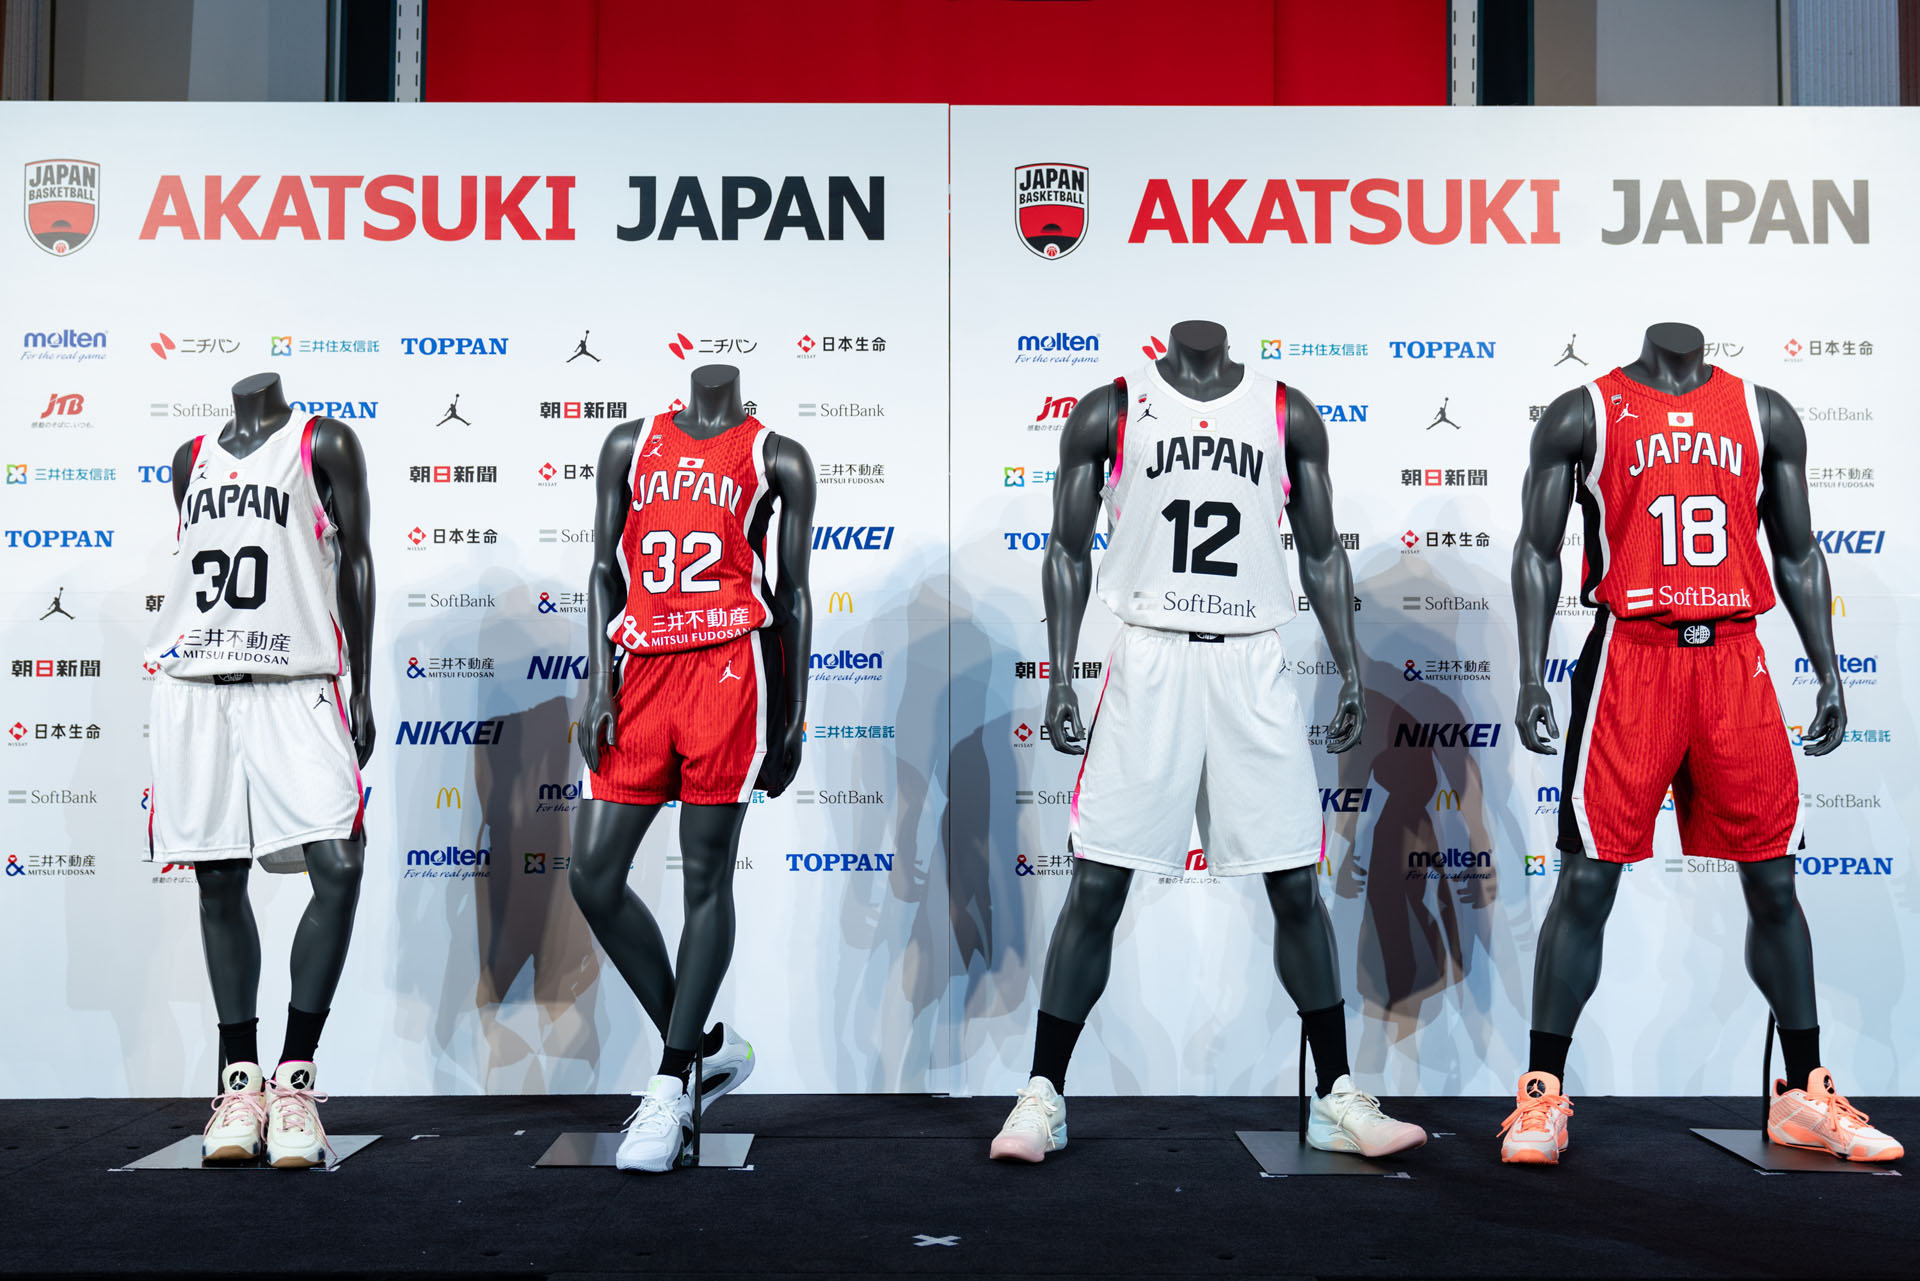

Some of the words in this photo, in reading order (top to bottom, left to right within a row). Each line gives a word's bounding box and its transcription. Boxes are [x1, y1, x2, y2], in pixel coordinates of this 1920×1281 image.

[29, 164, 95, 189] JAPAN
[1019, 168, 1085, 192] JAPAN
[29, 188, 95, 201] BASKETBALL
[1019, 191, 1085, 205] BASKETBALL
[138, 174, 576, 242] AKATSUKI
[617, 175, 885, 242] JAPAN
[1127, 177, 1561, 245] AKATSUKI
[1601, 179, 1870, 245] JAPAN
[24, 329, 107, 348] molten
[181, 338, 240, 354] ニチバン
[299, 340, 380, 353] 三井住友信託
[401, 337, 508, 355] TOPPAN
[698, 338, 757, 354] ニチバン
[823, 336, 887, 352] 日本生命
[1018, 332, 1099, 351] molten
[20, 350, 37, 361] For
[39, 350, 55, 360] the
[56, 350, 77, 360] real
[79, 353, 107, 363] game
[1288, 343, 1368, 356] 三井住友信託
[1389, 341, 1496, 359] TOPPAN
[1703, 341, 1744, 358] チバン
[1809, 340, 1873, 356] 日本生命
[1015, 353, 1030, 363] For
[1032, 353, 1048, 363] the
[1049, 353, 1070, 363] real
[1072, 356, 1099, 366] game
[40, 393, 85, 419] JTB
[289, 401, 378, 418] OPPAN
[540, 402, 627, 419] 朝日新聞
[820, 403, 885, 417] SoftBank
[1316, 404, 1368, 422] PAN
[1808, 407, 1874, 421] SoftBank
[1146, 435, 1264, 486] JAPAN
[1628, 431, 1743, 478] JAPAN
[35, 468, 116, 481] 三井住友信託
[410, 465, 497, 483] 朝日新聞
[819, 464, 885, 476] 三井不動産
[1401, 469, 1487, 486] 朝日新聞
[1809, 468, 1874, 480] 三井不動産
[632, 469, 744, 517] JAPAN
[185, 484, 290, 528] JAPAN
[5, 530, 114, 548] TOPPAN
[433, 528, 498, 544] 日本生命
[811, 526, 895, 550] IKKEI
[1161, 499, 1241, 577] 12
[1426, 531, 1490, 547] 日本生命
[1647, 495, 1728, 567] 18
[1812, 531, 1885, 554] KKEI
[641, 530, 723, 594] 32
[191, 545, 269, 614] 30
[430, 593, 495, 608] SoftBank
[1163, 590, 1257, 619] SoftBank
[1425, 597, 1490, 611] SoftBank
[1659, 586, 1751, 608] SoftBank
[651, 607, 750, 634] 三井不動産
[184, 628, 291, 653] 三井不動産
[651, 634, 689, 647] MITSUI
[183, 649, 225, 661] MITSUI
[227, 651, 290, 666] FUDOSAN
[428, 657, 495, 670] 三井不動産
[1795, 654, 1877, 673] mlten
[11, 659, 101, 677] 朝日新聞
[1296, 661, 1339, 675] SoftB
[1425, 660, 1490, 673] 三井不動産
[854, 675, 883, 684] game
[1850, 678, 1877, 689] game
[35, 723, 101, 740] 日本生命
[395, 721, 504, 745] NIKKEI
[814, 725, 895, 739] 三井住友信託
[1394, 723, 1502, 747] NIKKEI
[31, 789, 98, 804] SoftBank
[819, 790, 884, 804] SoftBank
[1816, 794, 1881, 808] SoftBank
[28, 855, 96, 867] 三井不動産
[407, 847, 490, 866] molten
[786, 853, 895, 872] TOPPAN
[1408, 848, 1490, 867] molten
[404, 869, 420, 879] For
[421, 869, 438, 878] the
[440, 869, 460, 878] real
[462, 871, 491, 880] game
[1687, 859, 1738, 873] SoftBa
